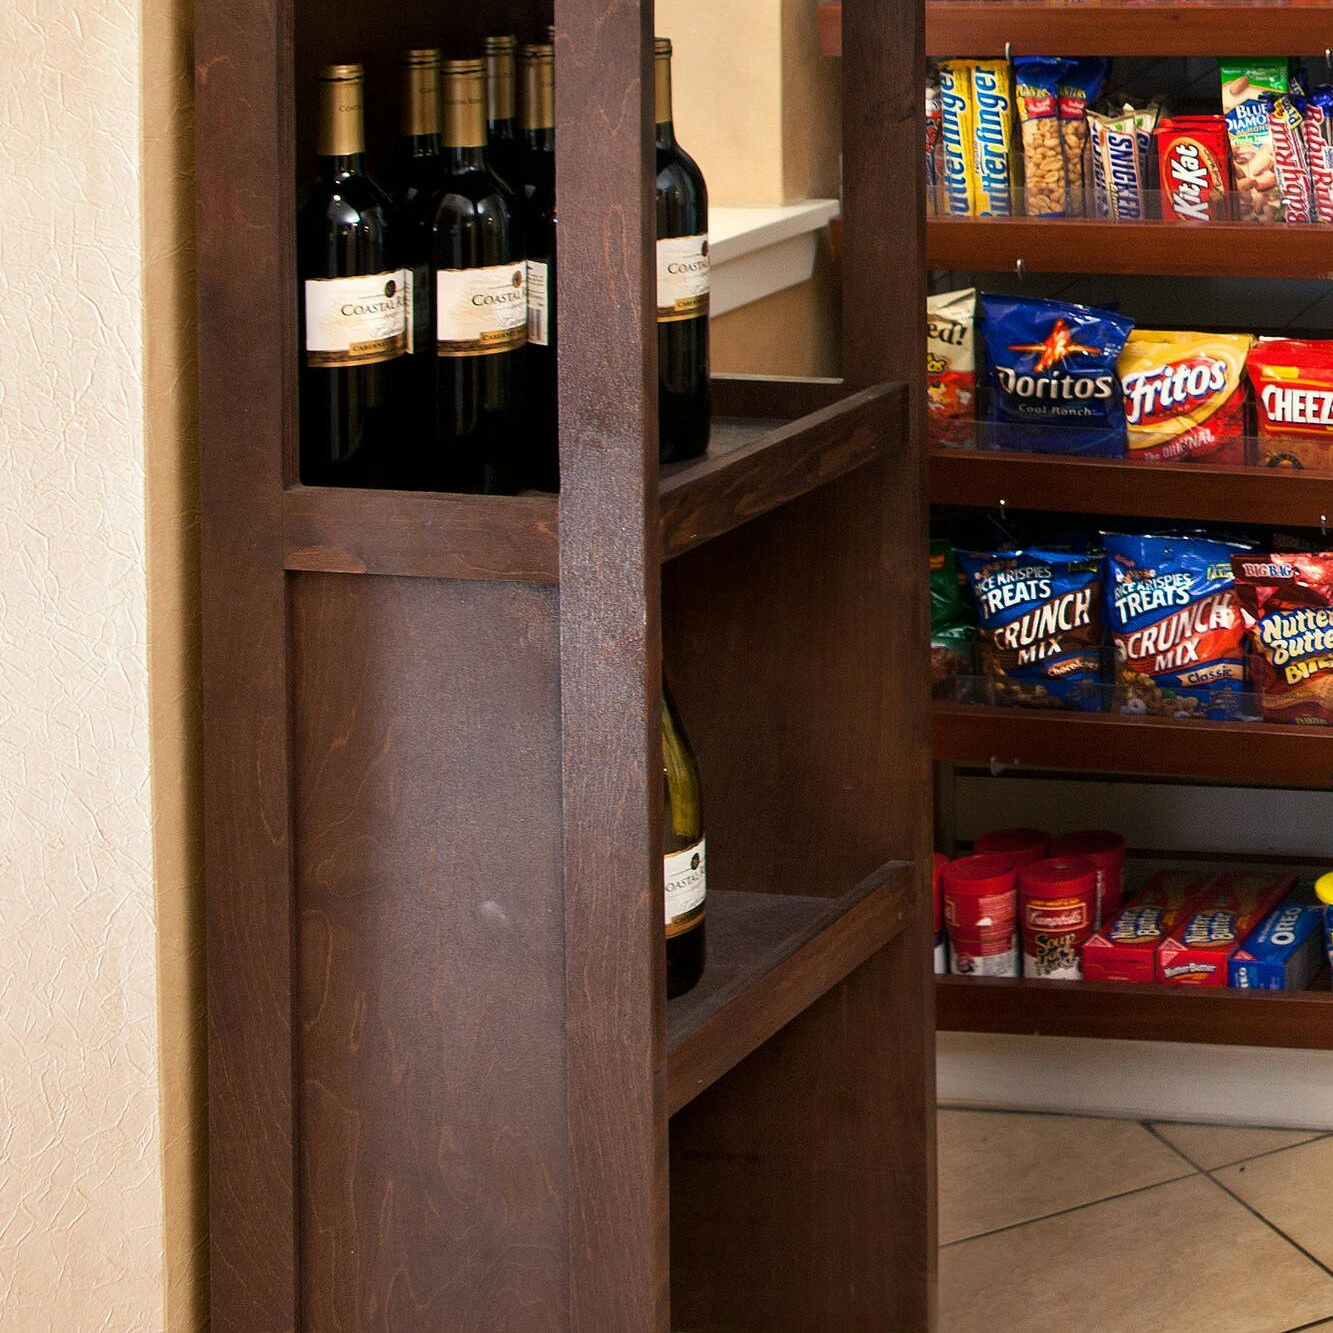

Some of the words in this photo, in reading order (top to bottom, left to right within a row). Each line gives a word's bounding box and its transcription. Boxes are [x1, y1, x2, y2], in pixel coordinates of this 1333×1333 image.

[340, 294, 396, 317] COASTAL
[471, 290, 521, 307] COASTAL
[996, 366, 1112, 400] Doritos
[1122, 360, 1227, 424] Fritos
[1018, 403, 1047, 415] Cool
[1052, 405, 1092, 416] Ranch
[994, 589, 1092, 650] CRUNCH
[1115, 585, 1191, 624] TREATS
[1018, 637, 1062, 665] MIX
[1155, 638, 1200, 671] MIX
[1187, 664, 1232, 686] Classic
